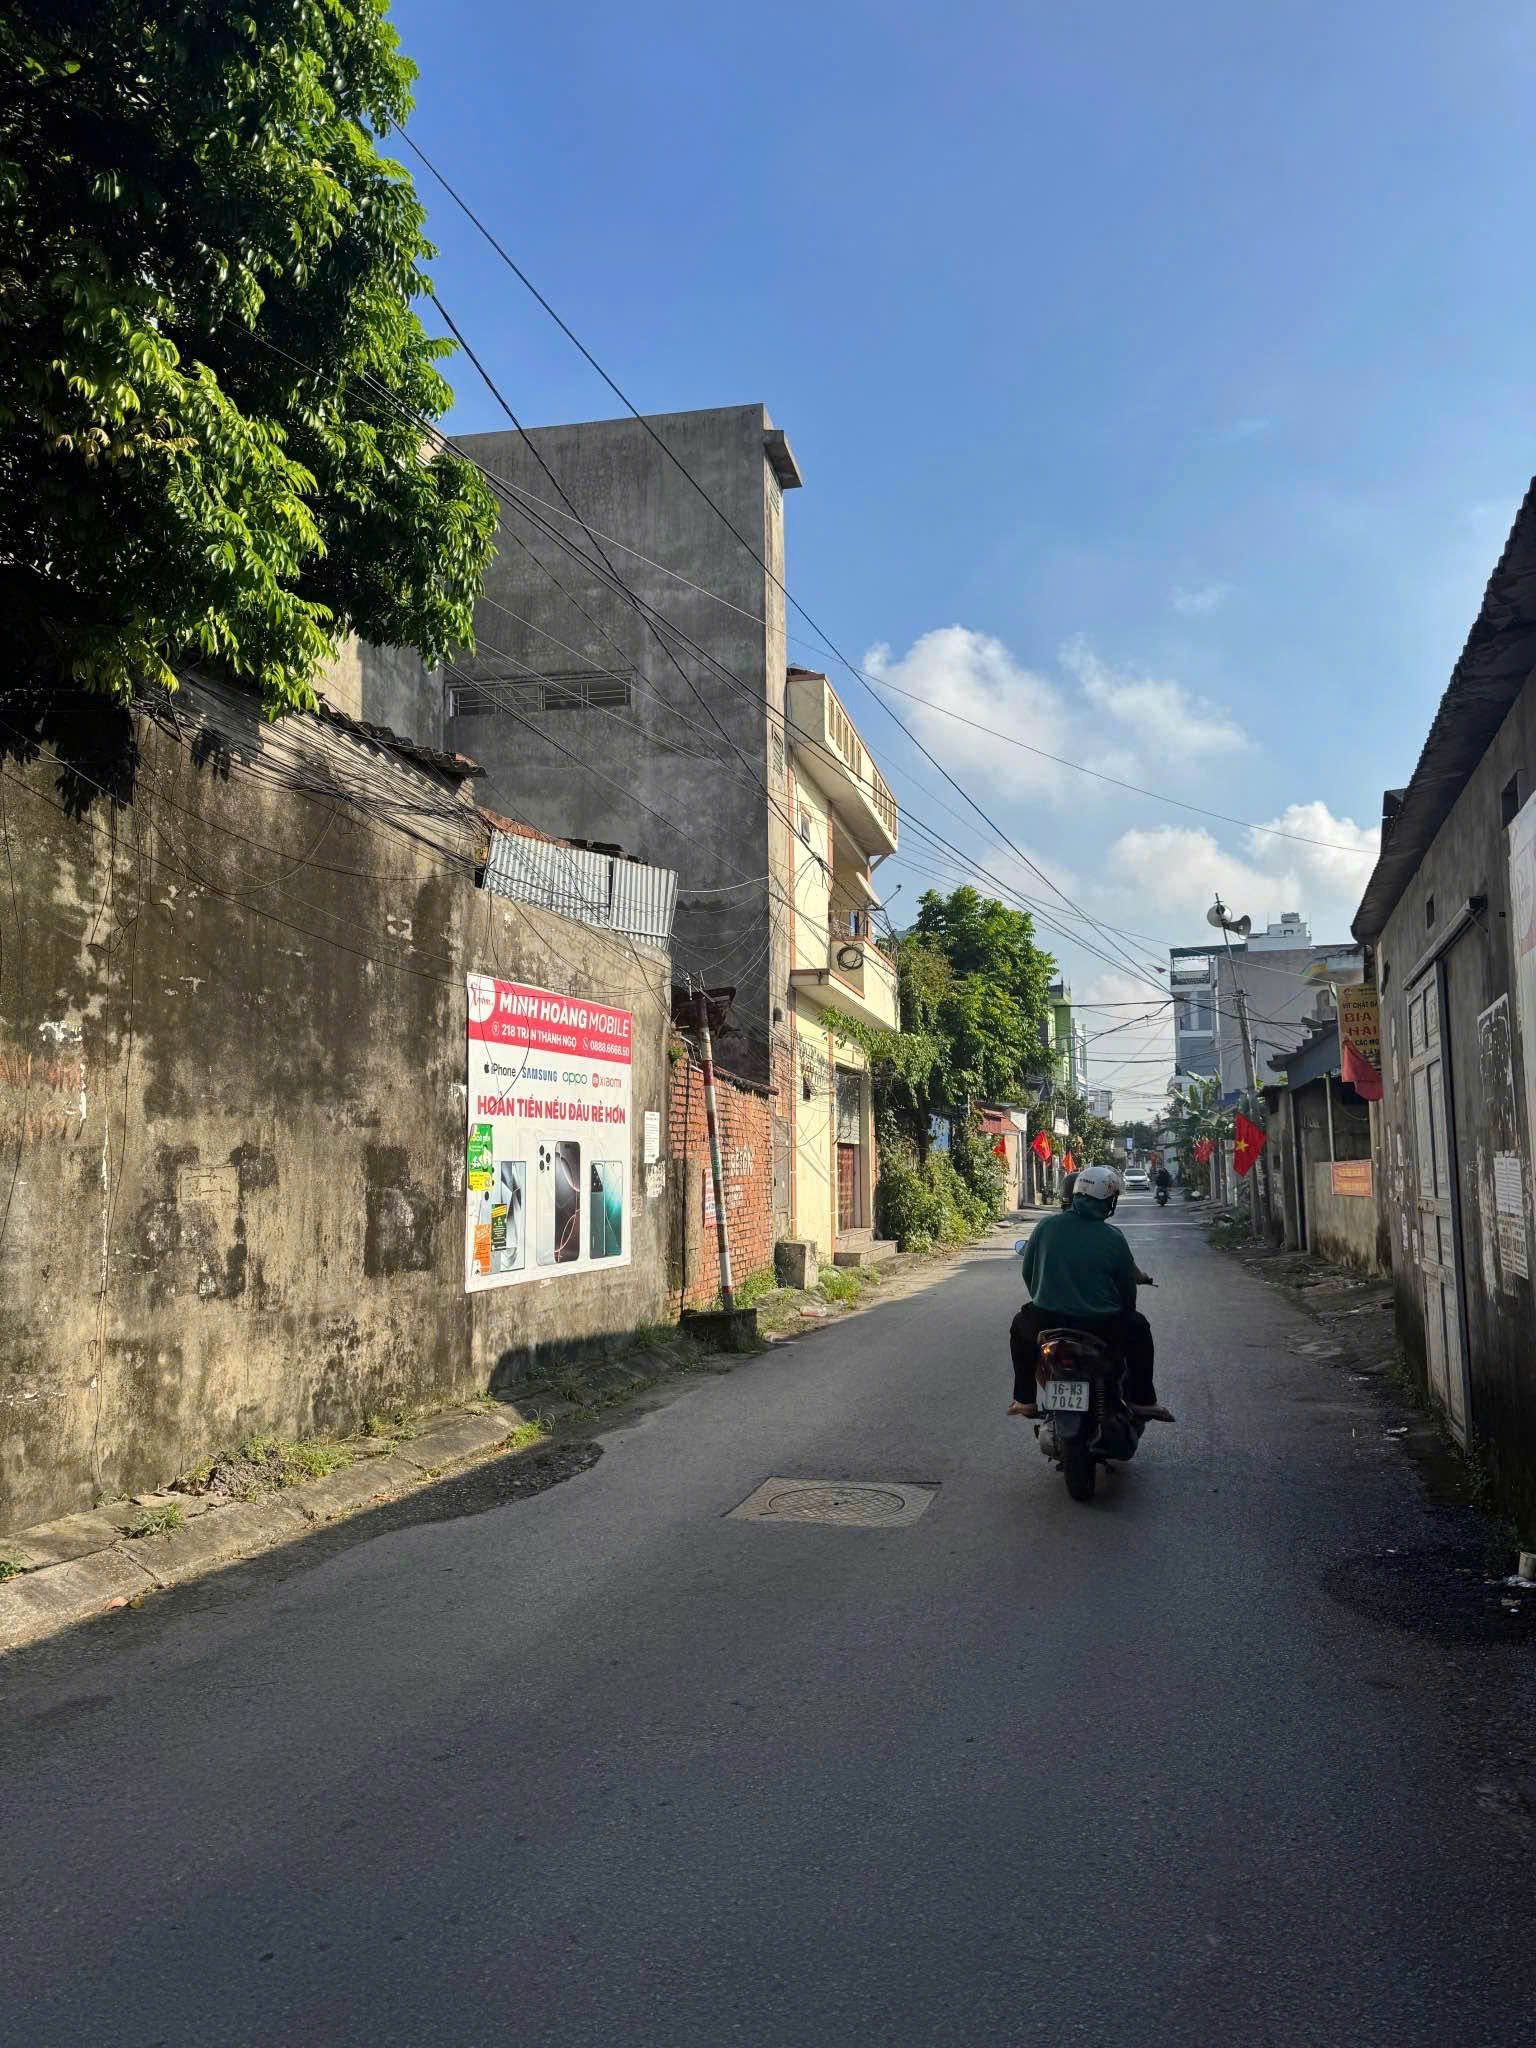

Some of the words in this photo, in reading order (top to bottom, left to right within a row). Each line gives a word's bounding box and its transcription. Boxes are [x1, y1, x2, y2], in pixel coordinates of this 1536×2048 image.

[500, 991, 538, 1020] MINH
[540, 1000, 586, 1028] HOÀNG
[589, 1012, 629, 1037] MOBILE
[1344, 1012, 1372, 1022] BIA
[502, 1023, 516, 1037] 218
[491, 1063, 516, 1077] iPhone
[522, 1066, 558, 1082] SAMSUNG
[477, 1091, 515, 1116] HOÀN
[545, 1096, 566, 1120] NẾU
[568, 1098, 589, 1121] ĐÂU
[1051, 1395, 1082, 1408] 7042
